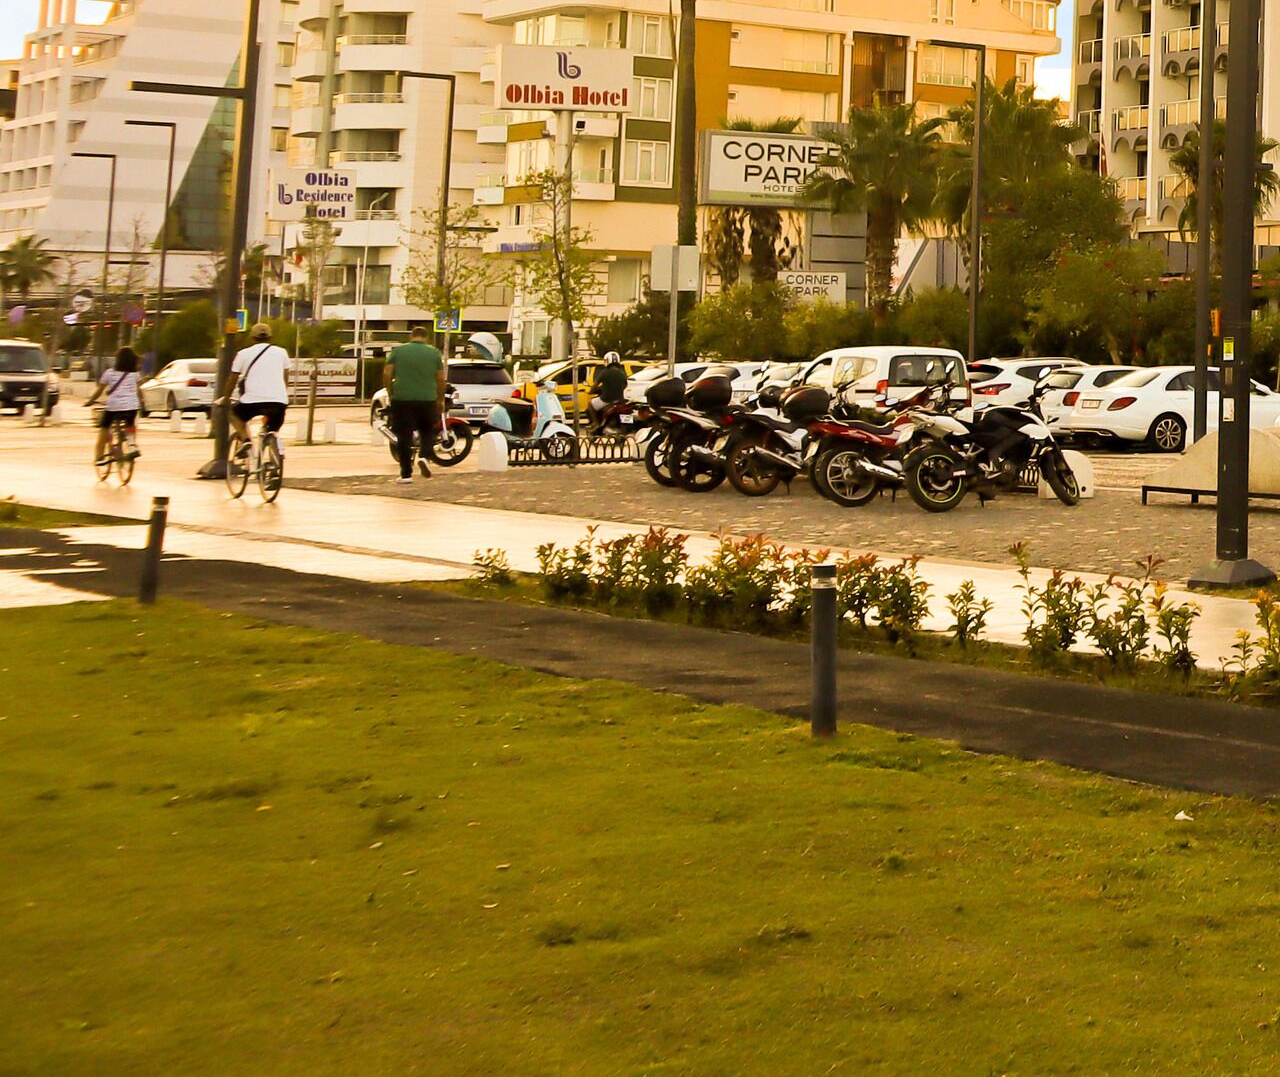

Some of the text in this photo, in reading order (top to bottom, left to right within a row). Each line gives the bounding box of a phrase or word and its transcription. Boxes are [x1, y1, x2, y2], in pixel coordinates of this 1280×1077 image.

[505, 84, 628, 107] Olbia Hotel
[305, 172, 349, 186] Olbia
[296, 189, 354, 202] Residence
[786, 275, 839, 285] CORNER
[795, 287, 829, 296] PARK
